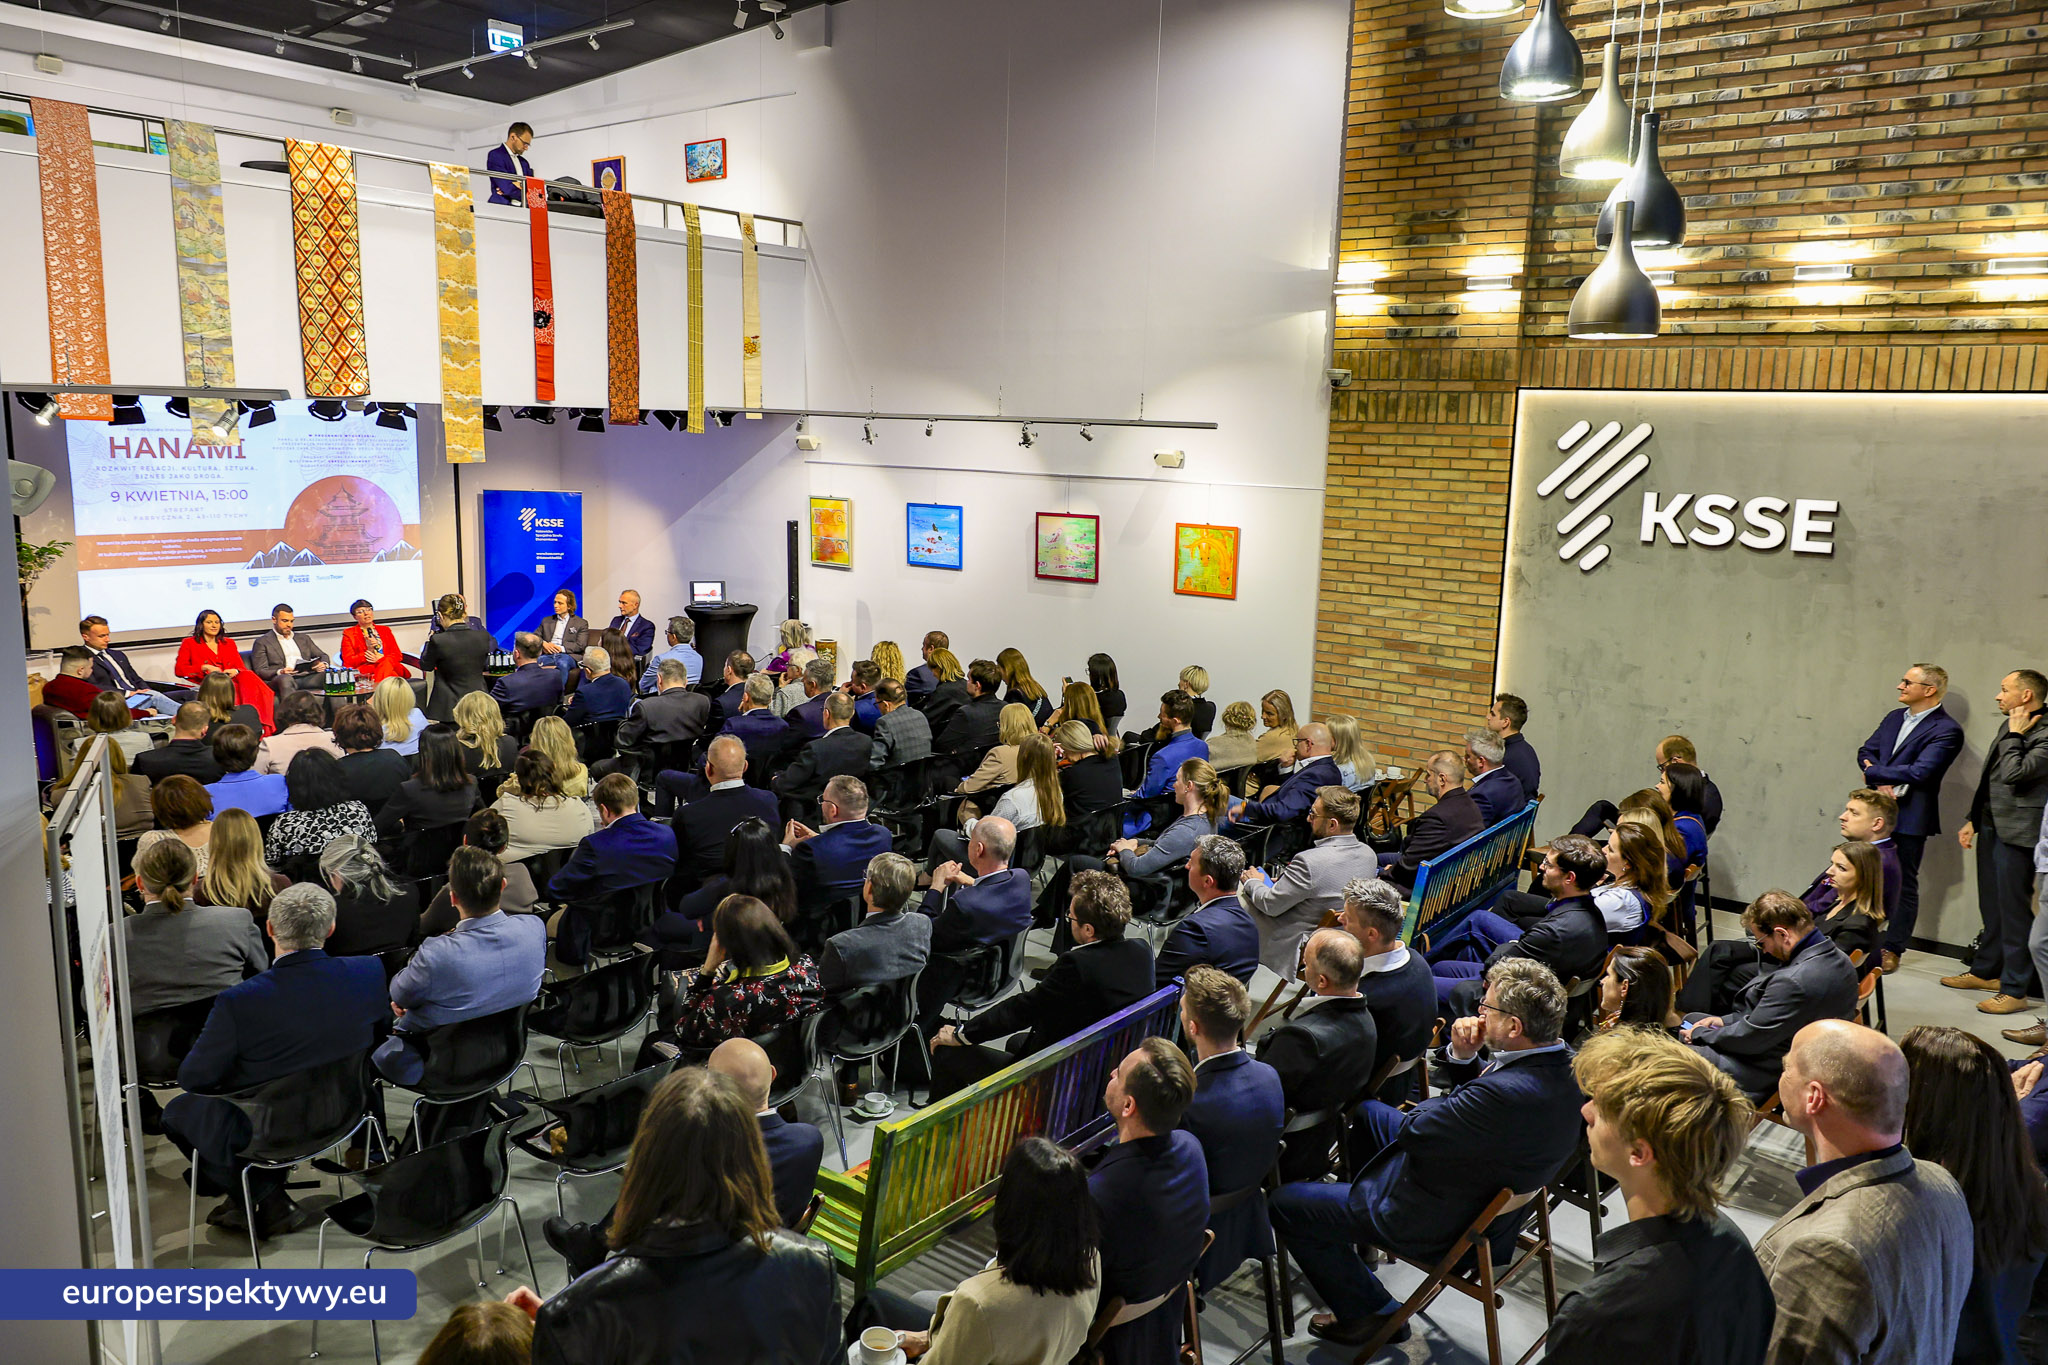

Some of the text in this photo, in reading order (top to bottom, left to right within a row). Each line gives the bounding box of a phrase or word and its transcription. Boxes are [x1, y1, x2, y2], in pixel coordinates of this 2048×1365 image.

[109, 436, 246, 459] HANAMI
[110, 489, 248, 502] 9 KWIETNIA, 15:00
[535, 518, 564, 528] KSSE
[1639, 491, 1839, 555] KSSE
